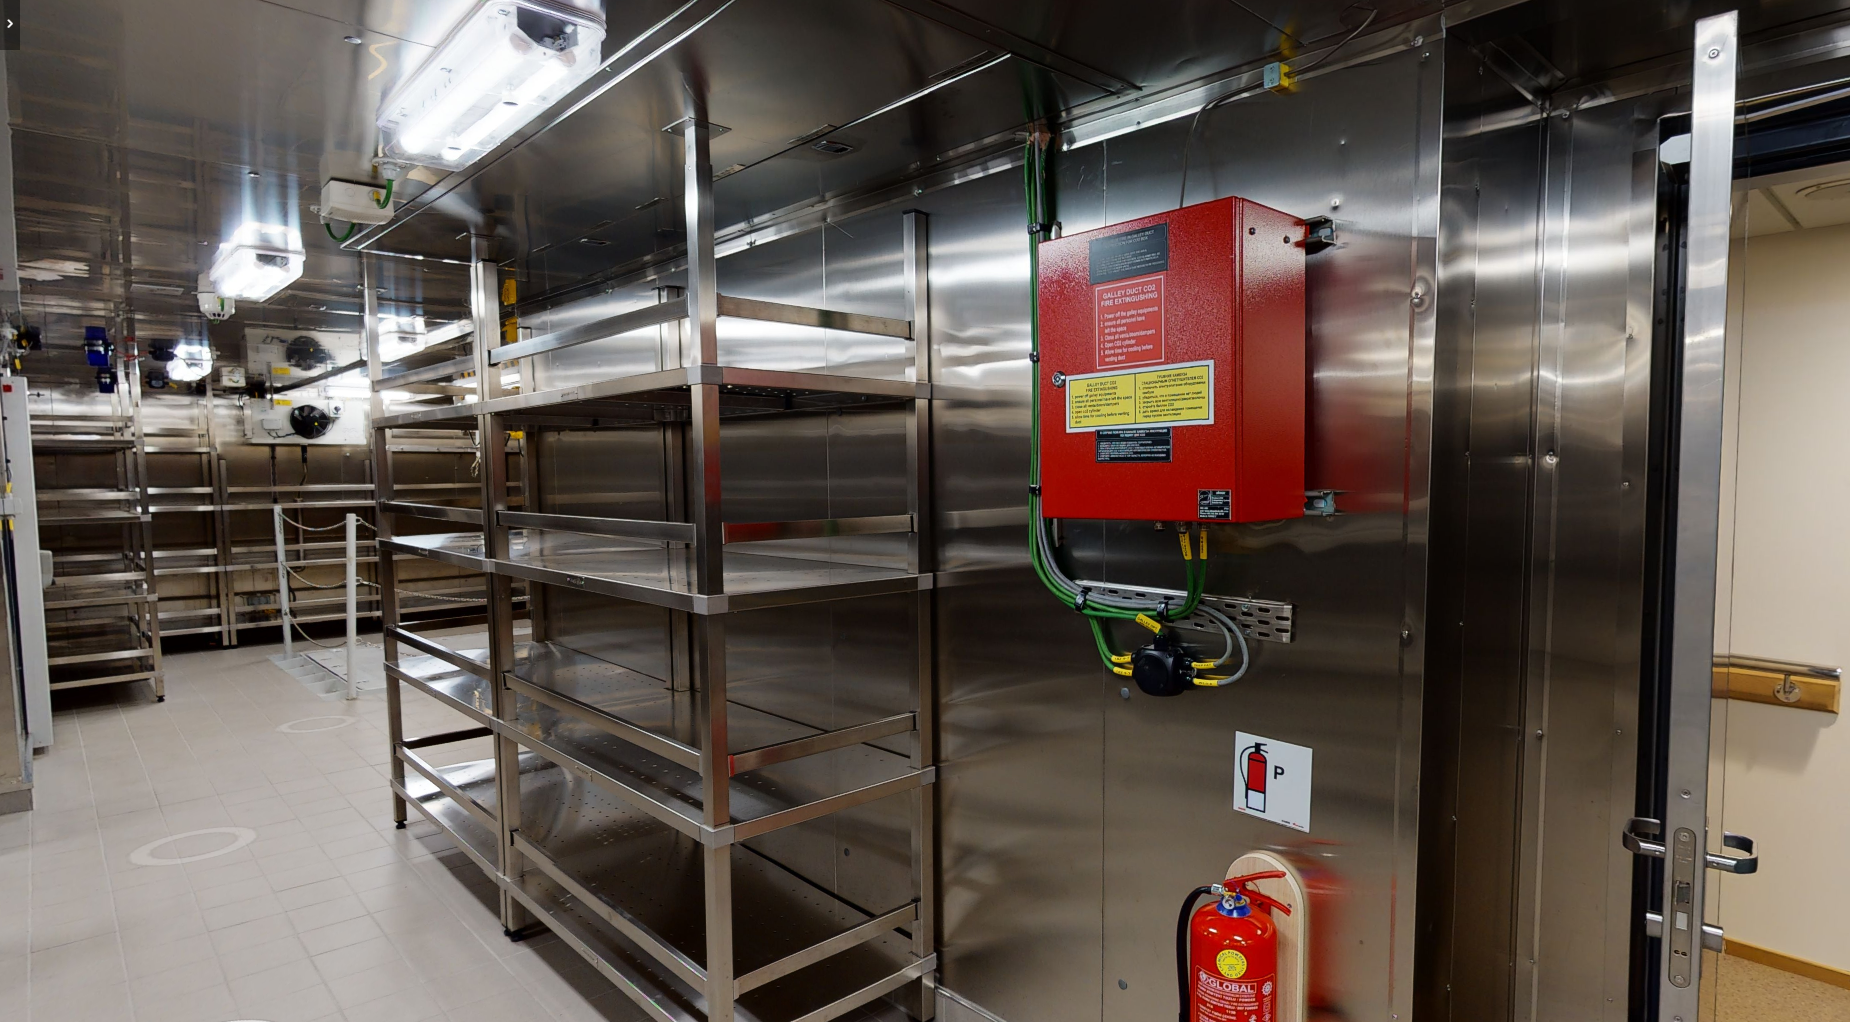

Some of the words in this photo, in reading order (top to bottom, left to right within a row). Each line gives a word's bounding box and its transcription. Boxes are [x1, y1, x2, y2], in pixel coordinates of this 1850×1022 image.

[1103, 290, 1125, 299] GALLEY
[1126, 287, 1142, 295] DUCT
[1274, 765, 1285, 780] P
[1209, 979, 1254, 993] GLOBAL
